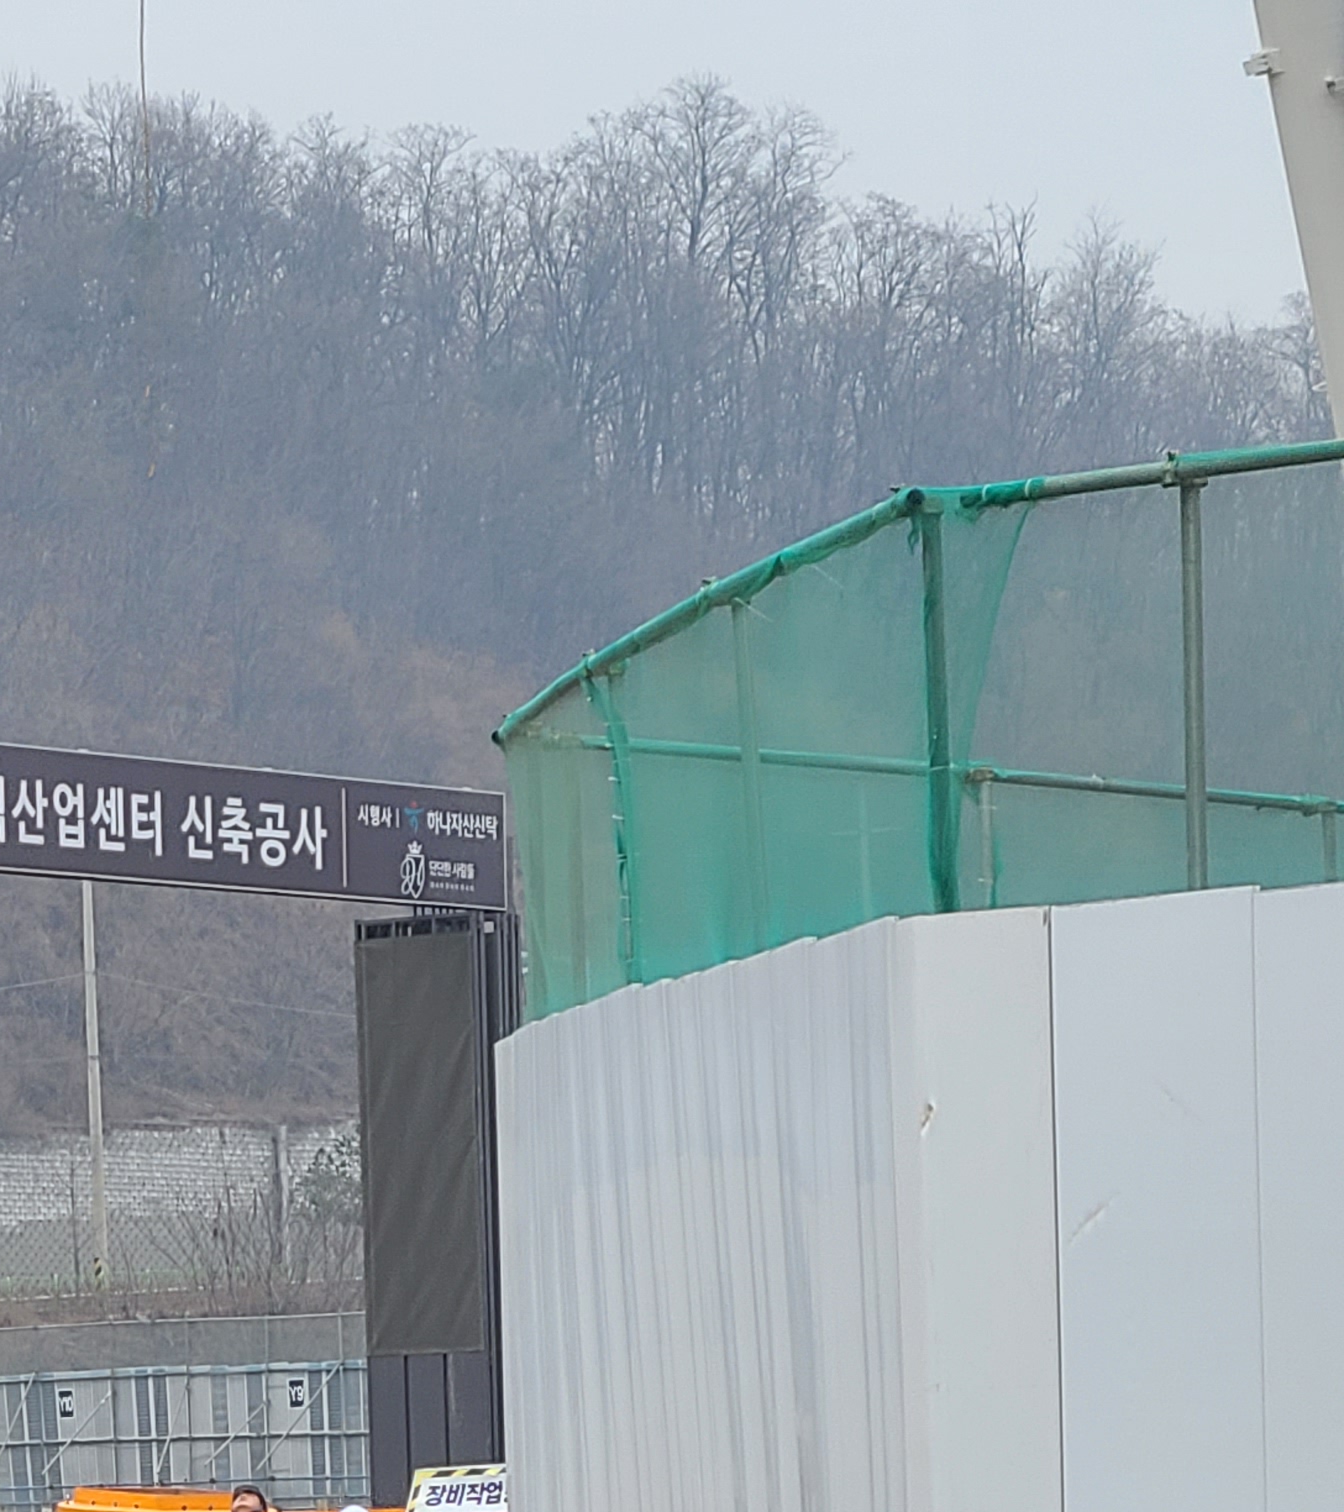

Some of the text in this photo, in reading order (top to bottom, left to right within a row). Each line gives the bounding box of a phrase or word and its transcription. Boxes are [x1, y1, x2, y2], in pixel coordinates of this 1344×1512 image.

[180, 794, 328, 870] 신축공사
[358, 803, 498, 840] 시행사 하나자산신탁
[289, 1385, 304, 1402] Y9
[424, 1480, 509, 1506] 장비작업
